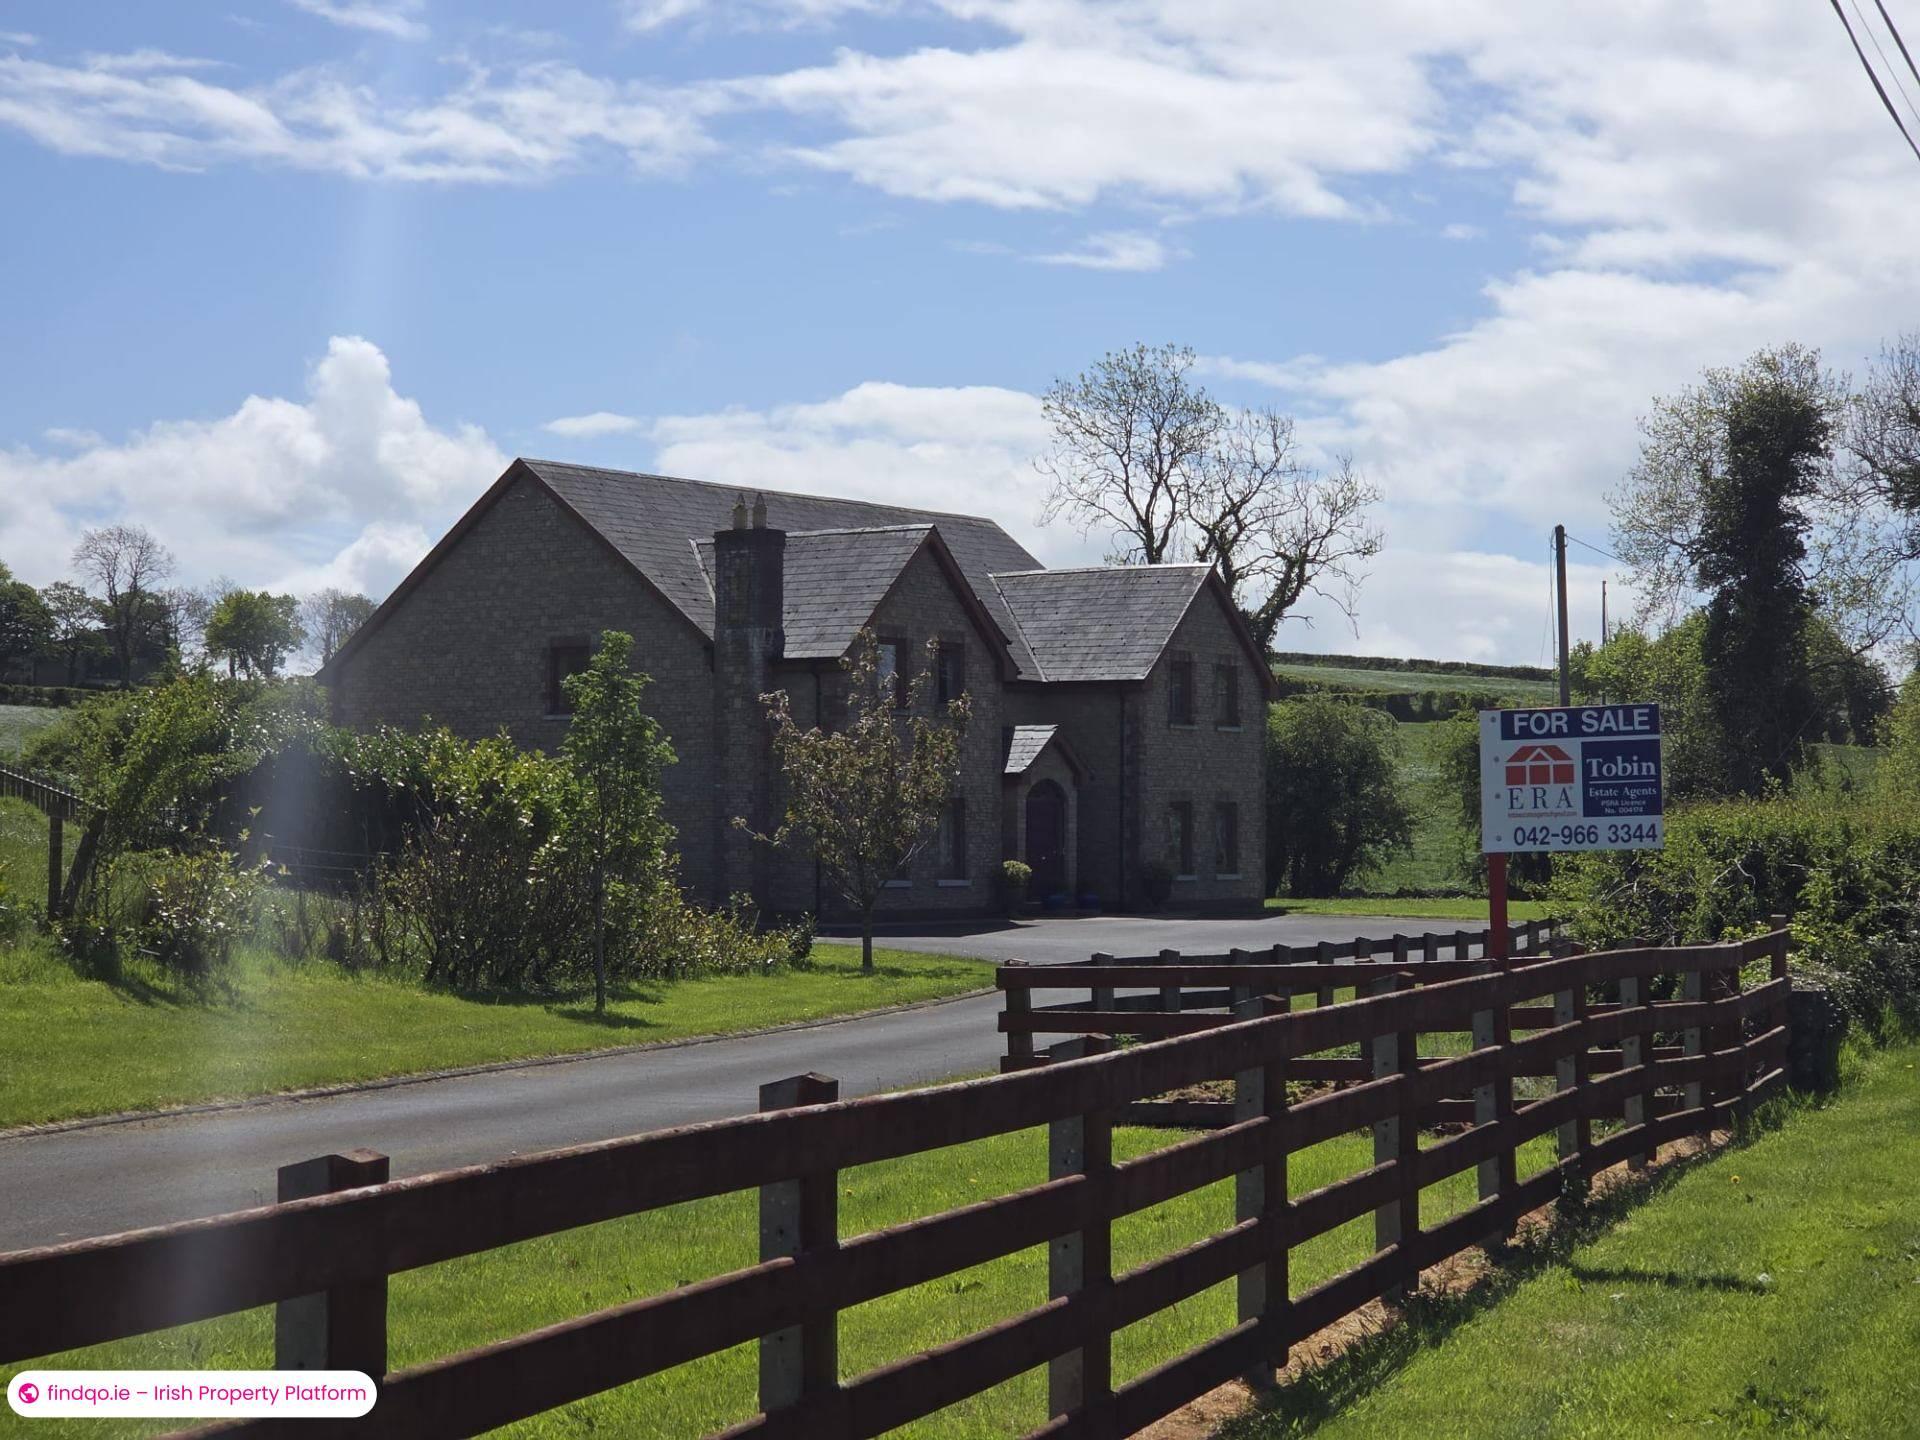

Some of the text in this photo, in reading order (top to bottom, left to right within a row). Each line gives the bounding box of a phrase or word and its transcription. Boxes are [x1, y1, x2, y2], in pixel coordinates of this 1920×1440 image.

[1513, 708, 1650, 736] FOR SALE
[1586, 755, 1657, 778] Tobin
[1507, 787, 1574, 810] ERA
[1589, 786, 1657, 800] Estate Agents
[1513, 823, 1658, 846] 042-966 3344
